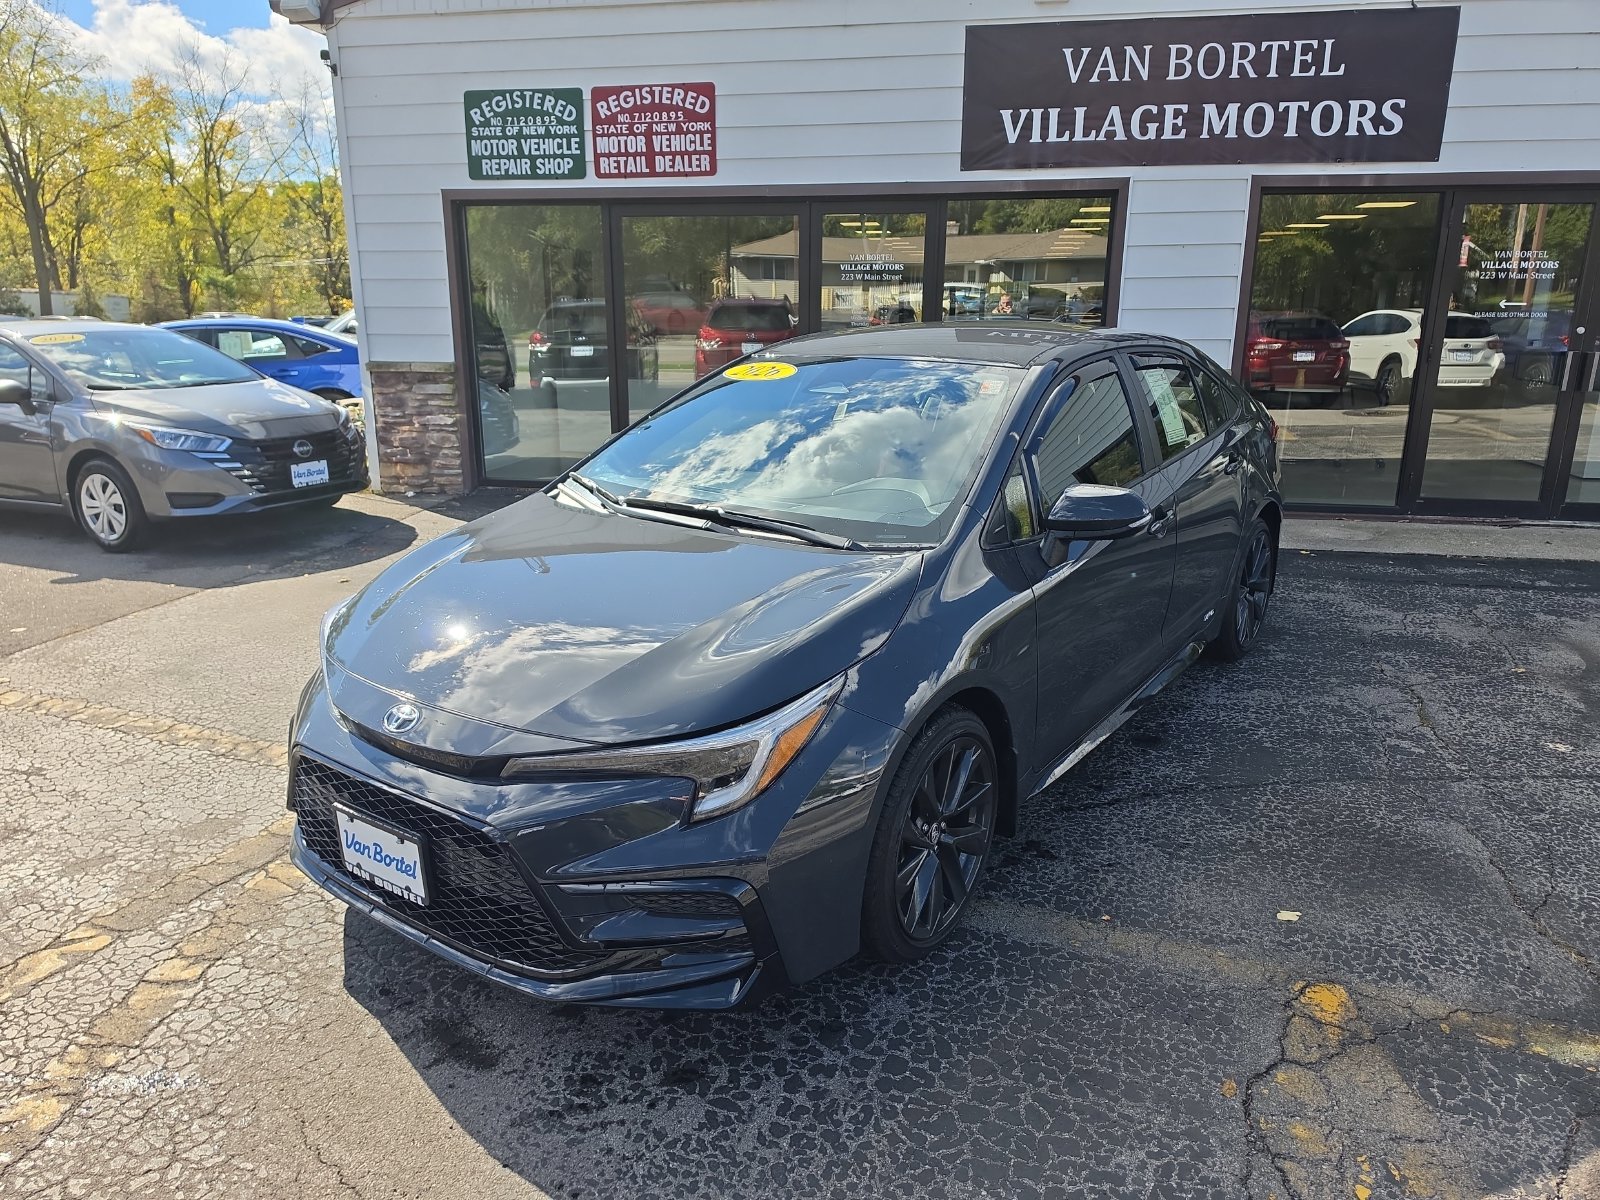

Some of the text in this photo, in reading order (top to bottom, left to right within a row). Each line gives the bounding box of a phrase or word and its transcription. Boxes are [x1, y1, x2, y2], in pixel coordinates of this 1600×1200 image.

[1062, 39, 1346, 84] VAN BORTEL
[470, 91, 577, 125] REGISTERED
[596, 86, 710, 119] REGISTERED
[506, 116, 556, 126] 7120895
[633, 112, 684, 122] 7120895
[1000, 98, 1406, 144] VILLAGE MOTORS
[472, 125, 578, 136] STATE OF NEW YORK
[596, 122, 712, 134] STATE OF NEW YORK
[471, 138, 580, 156] MOTOR VEHICLE
[596, 134, 712, 154] MOTOR VEHICLE
[482, 158, 573, 175] REPAIR SHOP
[600, 155, 710, 174] RETAIL DEALER
